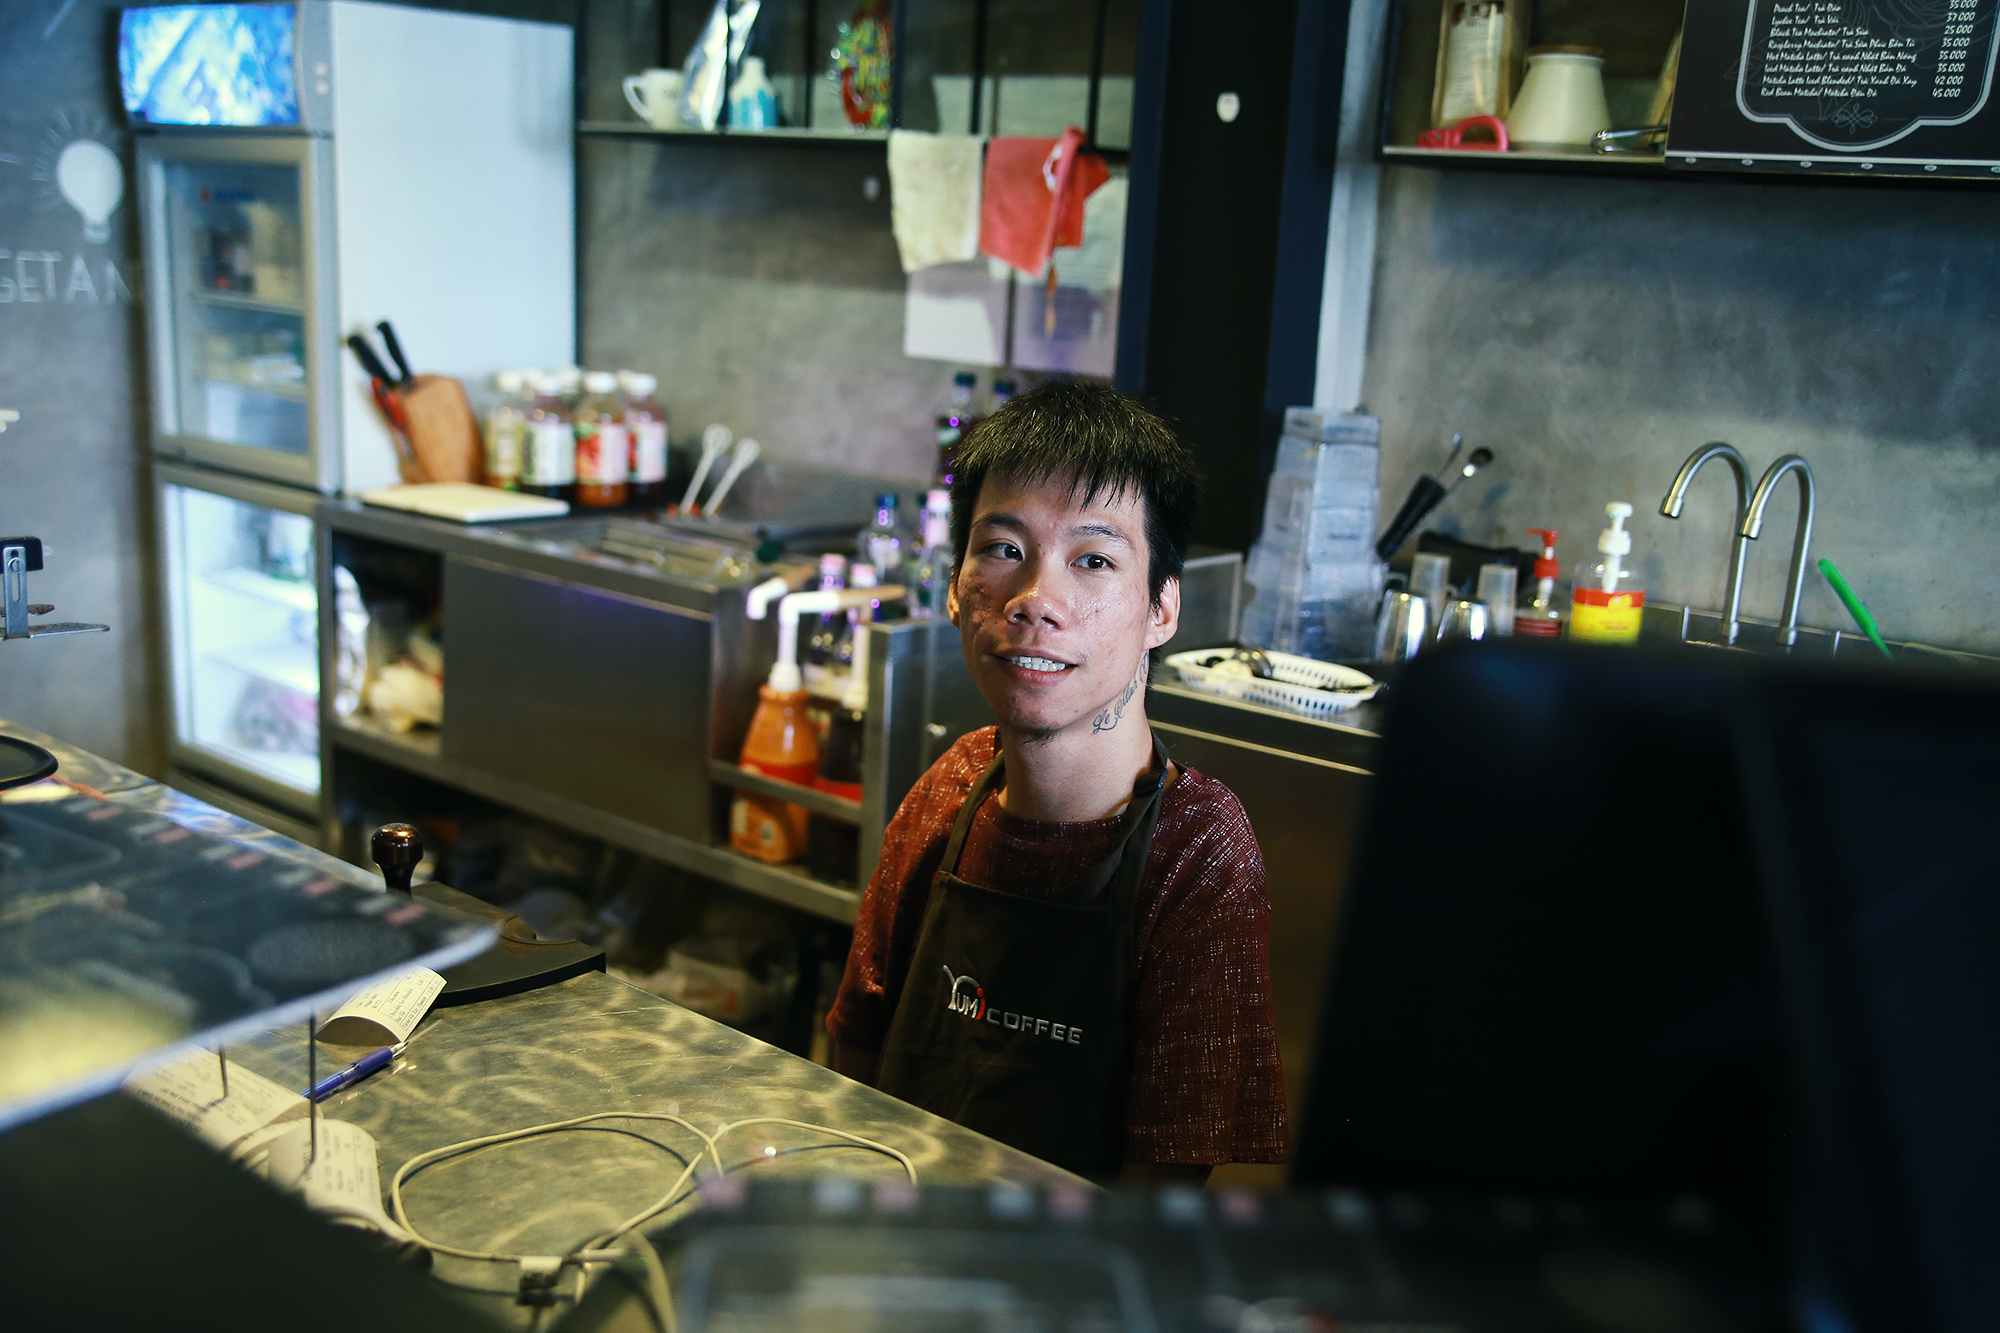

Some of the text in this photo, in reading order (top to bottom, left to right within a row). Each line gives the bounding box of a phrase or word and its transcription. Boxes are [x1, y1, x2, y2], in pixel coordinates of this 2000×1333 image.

[1770, 27, 1790, 37] Black
[1792, 27, 1802, 36] Tea
[1766, 52, 1779, 61] Hot
[1780, 51, 1804, 61] Matcha
[1779, 63, 1804, 72] Matcha
[1762, 75, 1786, 84] Matcha
[1788, 75, 1805, 84] Latte
[1761, 87, 1775, 96] Red
[1775, 87, 1793, 97] Bean
[1824, 87, 1849, 97] Matcha
[986, 1007, 1083, 1046] COFFEE
